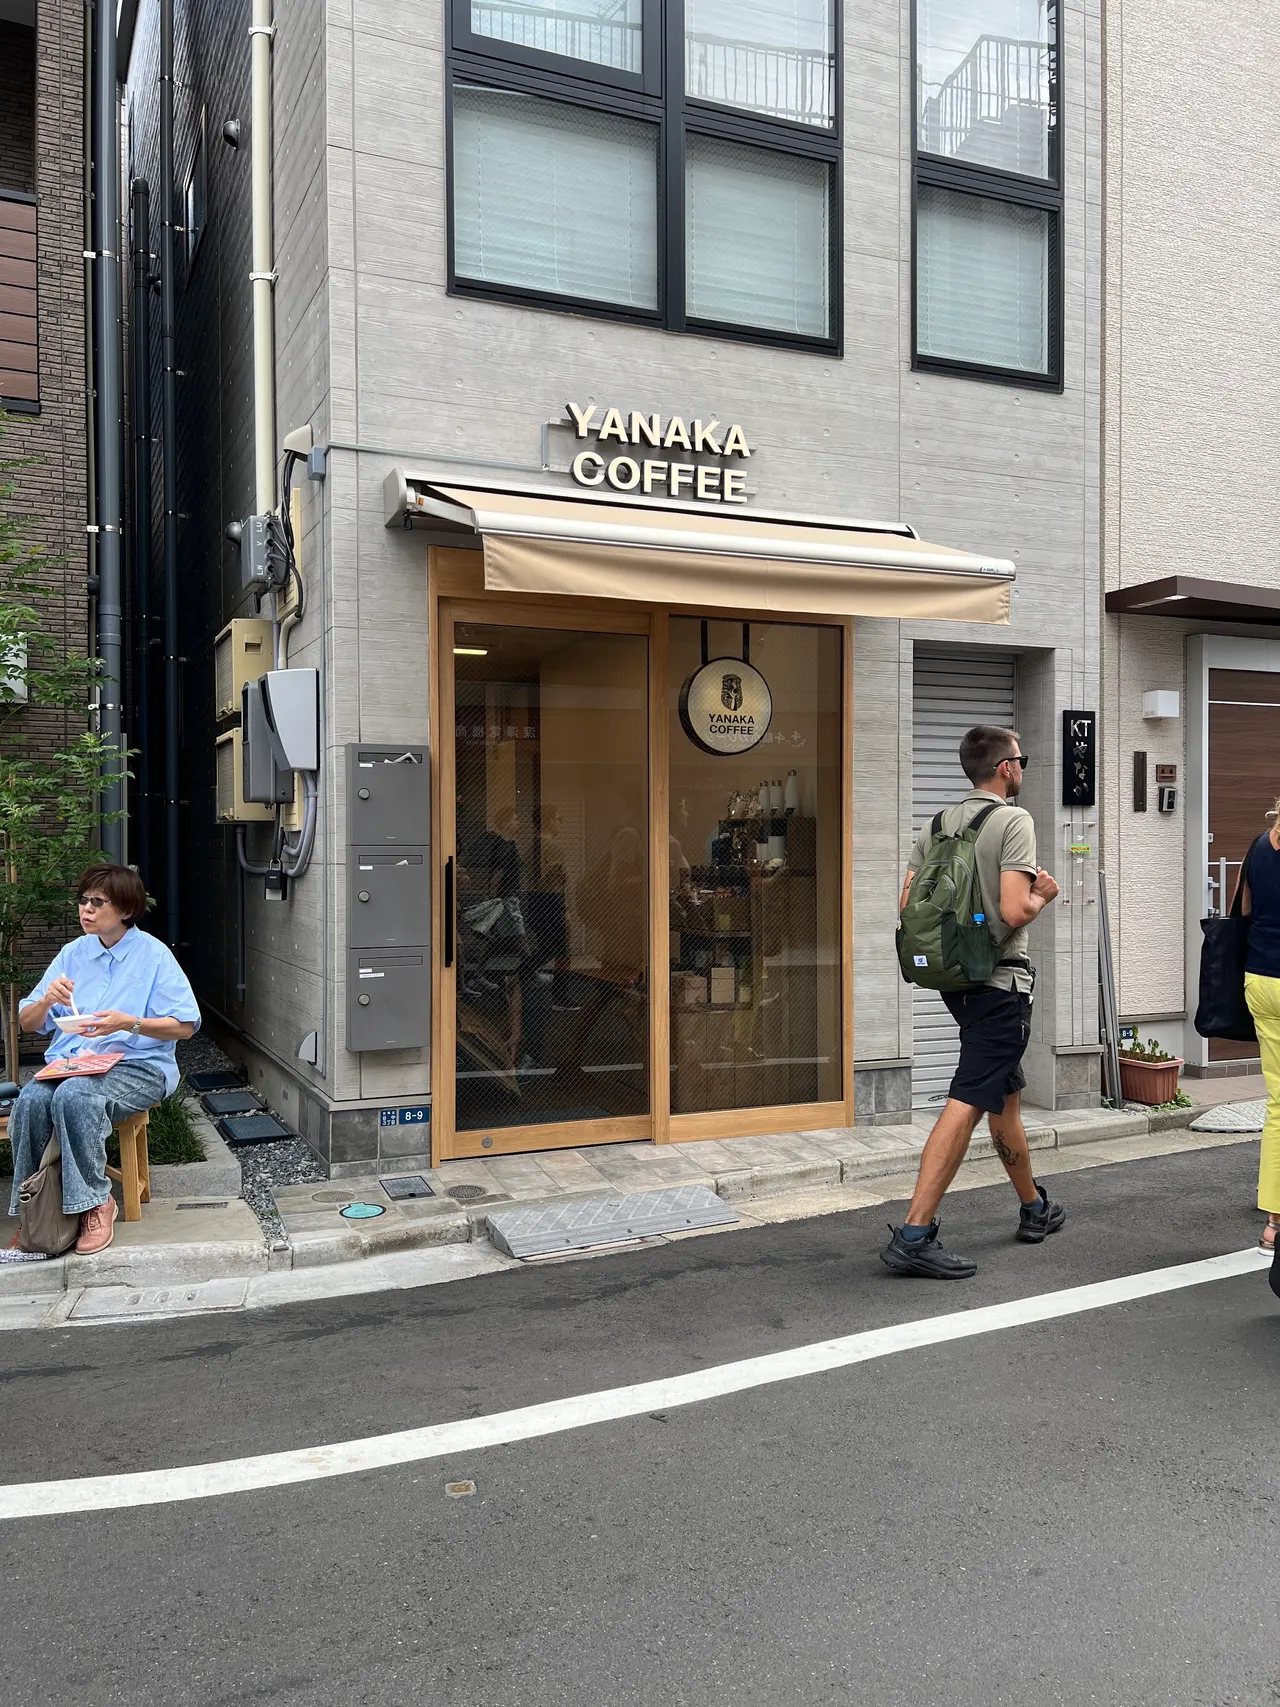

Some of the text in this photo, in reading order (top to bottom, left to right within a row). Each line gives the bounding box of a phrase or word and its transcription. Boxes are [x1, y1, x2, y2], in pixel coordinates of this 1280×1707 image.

[565, 402, 752, 459] YANAKA
[571, 451, 748, 504] COFFEE
[708, 713, 755, 725] YANAKA
[709, 725, 754, 735] COFFEE
[1071, 720, 1092, 737] KT
[406, 1110, 423, 1121] 8-9
